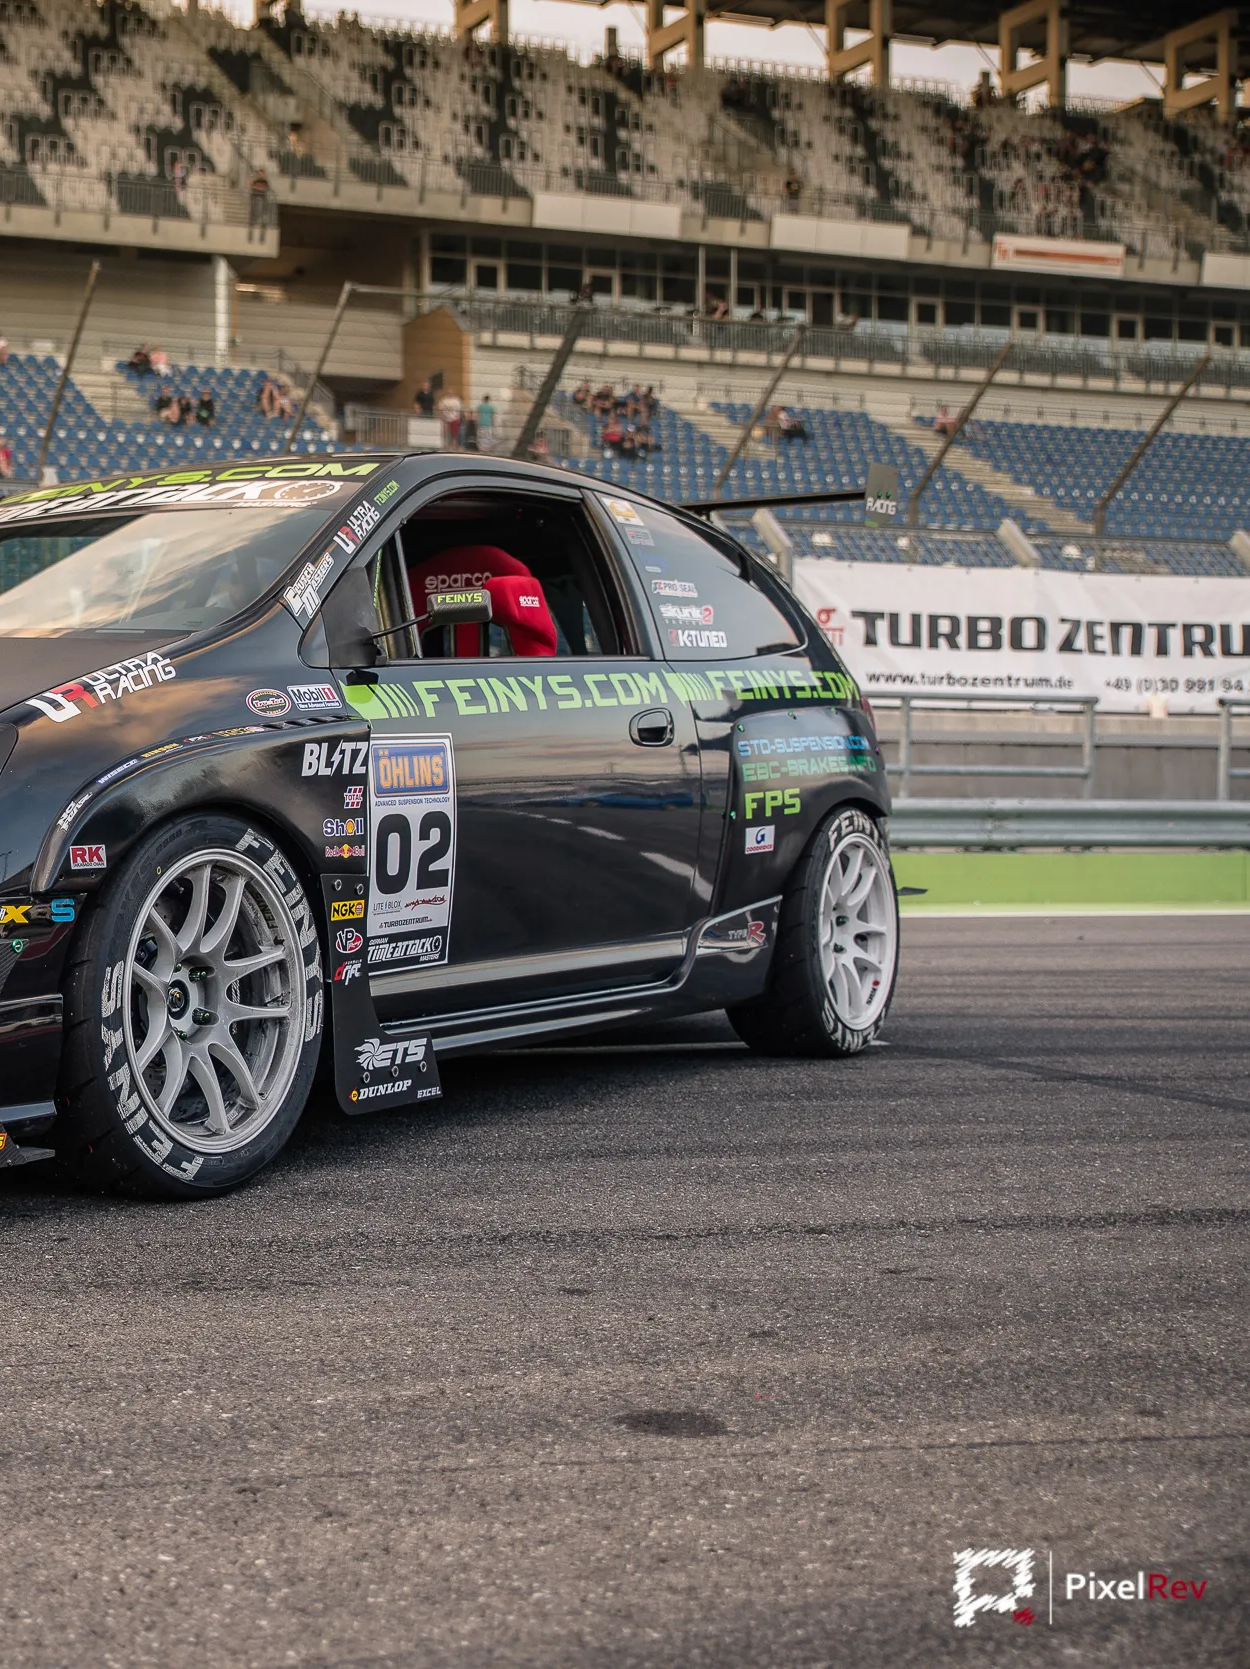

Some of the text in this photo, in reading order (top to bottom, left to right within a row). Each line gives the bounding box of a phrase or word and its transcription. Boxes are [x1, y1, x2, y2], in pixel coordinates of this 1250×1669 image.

[347, 500, 372, 530] ULTRA
[354, 507, 380, 540] RACING
[284, 562, 315, 616] CLUTCH
[302, 552, 335, 618] MASTERS
[437, 592, 483, 604] FEINYS
[850, 610, 1047, 652] TURBO
[81, 651, 163, 687] ULTRA
[94, 657, 177, 704] RACING
[412, 672, 667, 718] FEINYS.COM
[378, 749, 444, 789] ÖHLINS
[424, 796, 450, 804] TECHNOLOGY
[745, 788, 801, 820] FPS
[71, 846, 104, 863] RK
[375, 811, 452, 895] 02
[332, 903, 354, 918] NGK
[746, 921, 766, 944] R
[372, 1038, 428, 1068] ETS
[358, 1079, 412, 1100] DUNLOP
[417, 1086, 442, 1098] EXCEL
